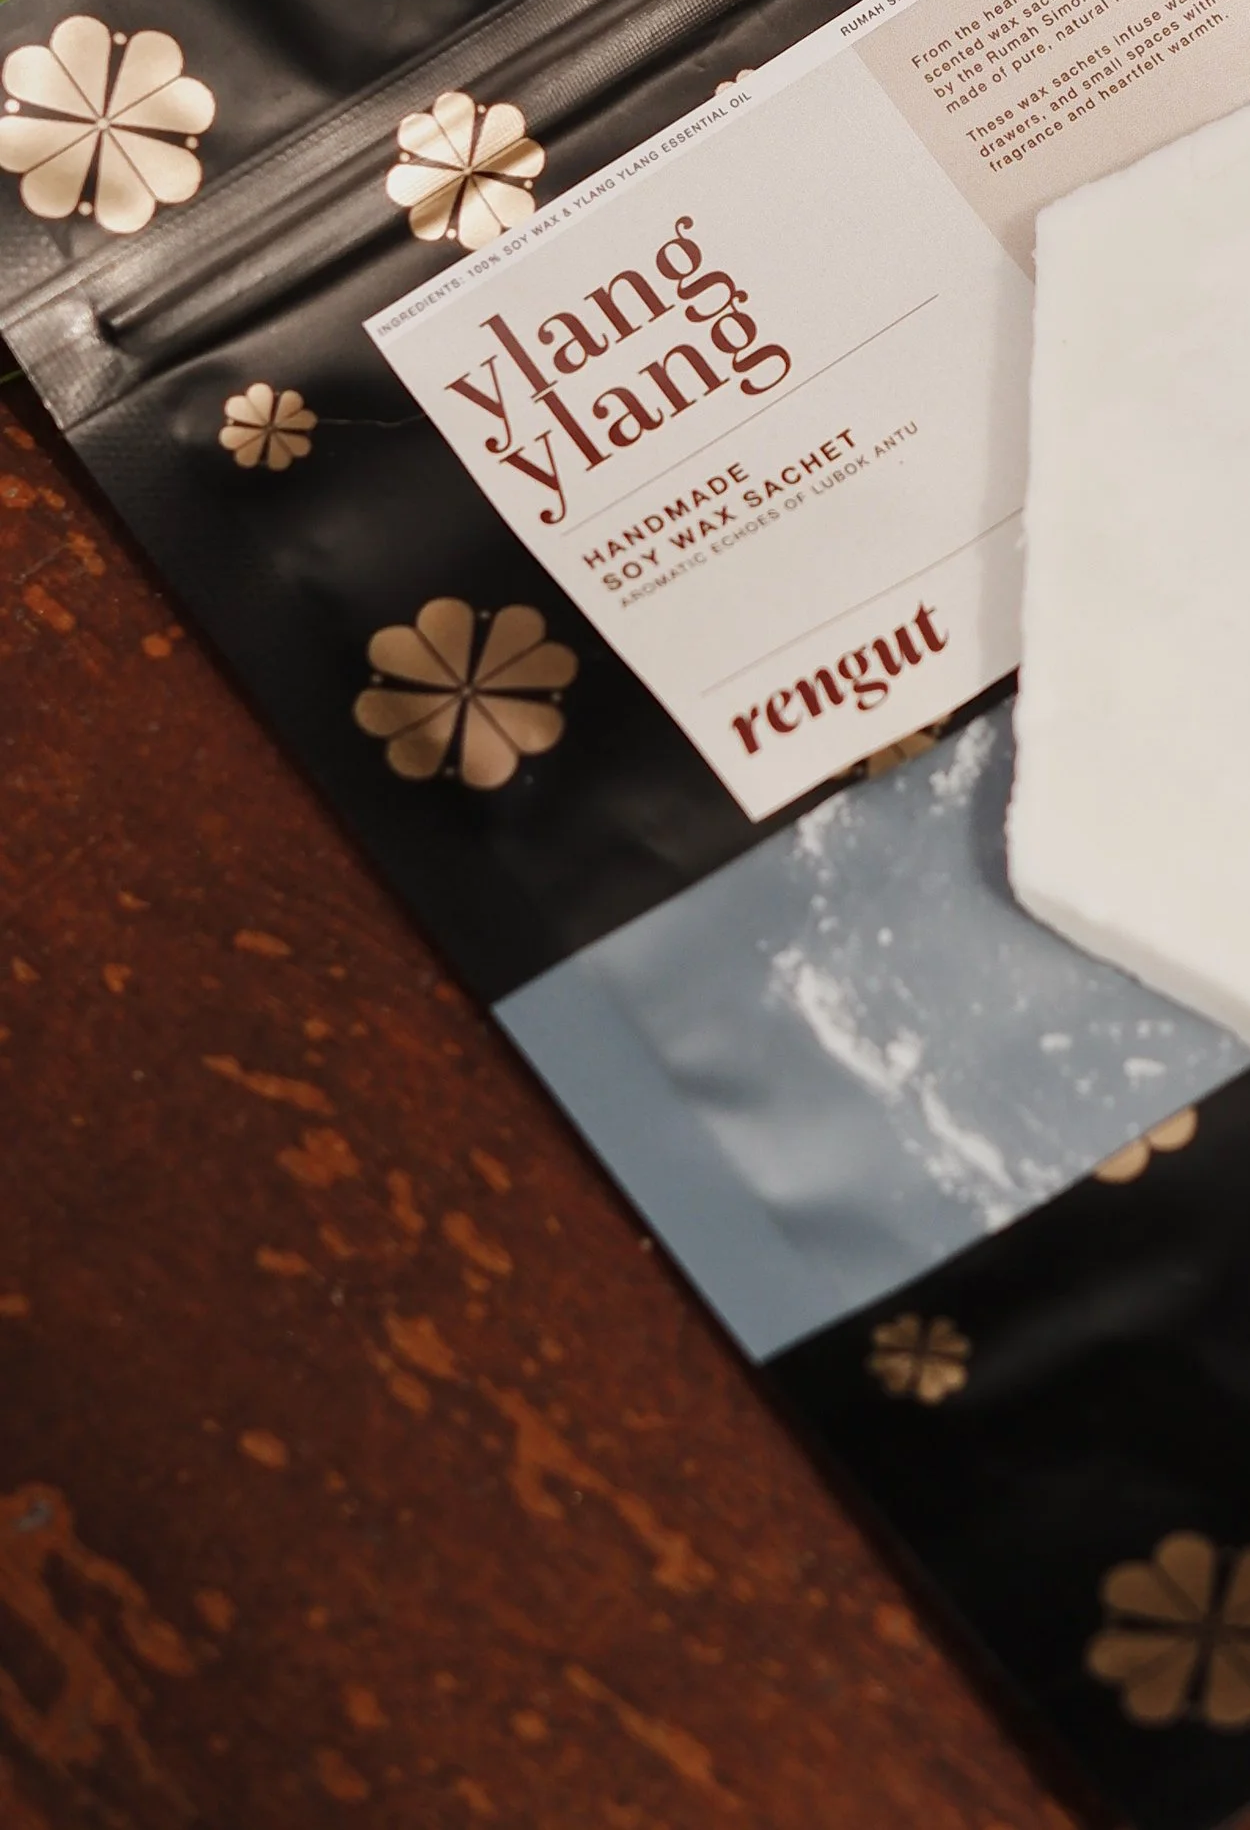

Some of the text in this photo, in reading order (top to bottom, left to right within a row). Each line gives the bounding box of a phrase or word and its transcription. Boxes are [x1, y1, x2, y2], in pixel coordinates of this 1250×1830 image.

[840, 2, 885, 36] RUMAH
[910, 39, 952, 69] From
[954, 20, 981, 40] the
[923, 37, 985, 83] scented
[987, 16, 1020, 40] wax
[932, 81, 954, 98] by
[956, 63, 983, 83] the
[985, 26, 1039, 64] Rumah
[945, 82, 988, 114] made
[991, 65, 1008, 83] of
[1011, 44, 1052, 73] pure,
[965, 109, 1014, 142] These
[1016, 86, 1049, 110] wax
[1051, 45, 1111, 88] sachets
[1112, 11, 1161, 46] infuse
[979, 114, 1047, 158] drawers,
[1049, 86, 1078, 112] and
[1081, 56, 1123, 90] small
[1126, 21, 1180, 60] spaces
[989, 13, 1229, 172] fragrance and heartfelt warmth.
[376, 91, 752, 336] INGREDIENTS: 100% SOY WAX & YLANG YLANG ESSENTIAL OIL
[445, 216, 737, 454] ylang
[500, 290, 792, 525] ylang
[582, 462, 749, 569] HANDMADE
[602, 428, 855, 591] SOY WAX SACHET
[621, 420, 918, 608] AROMATIC ECHOES OF LUBOK ANTU
[730, 600, 949, 755] rengut
